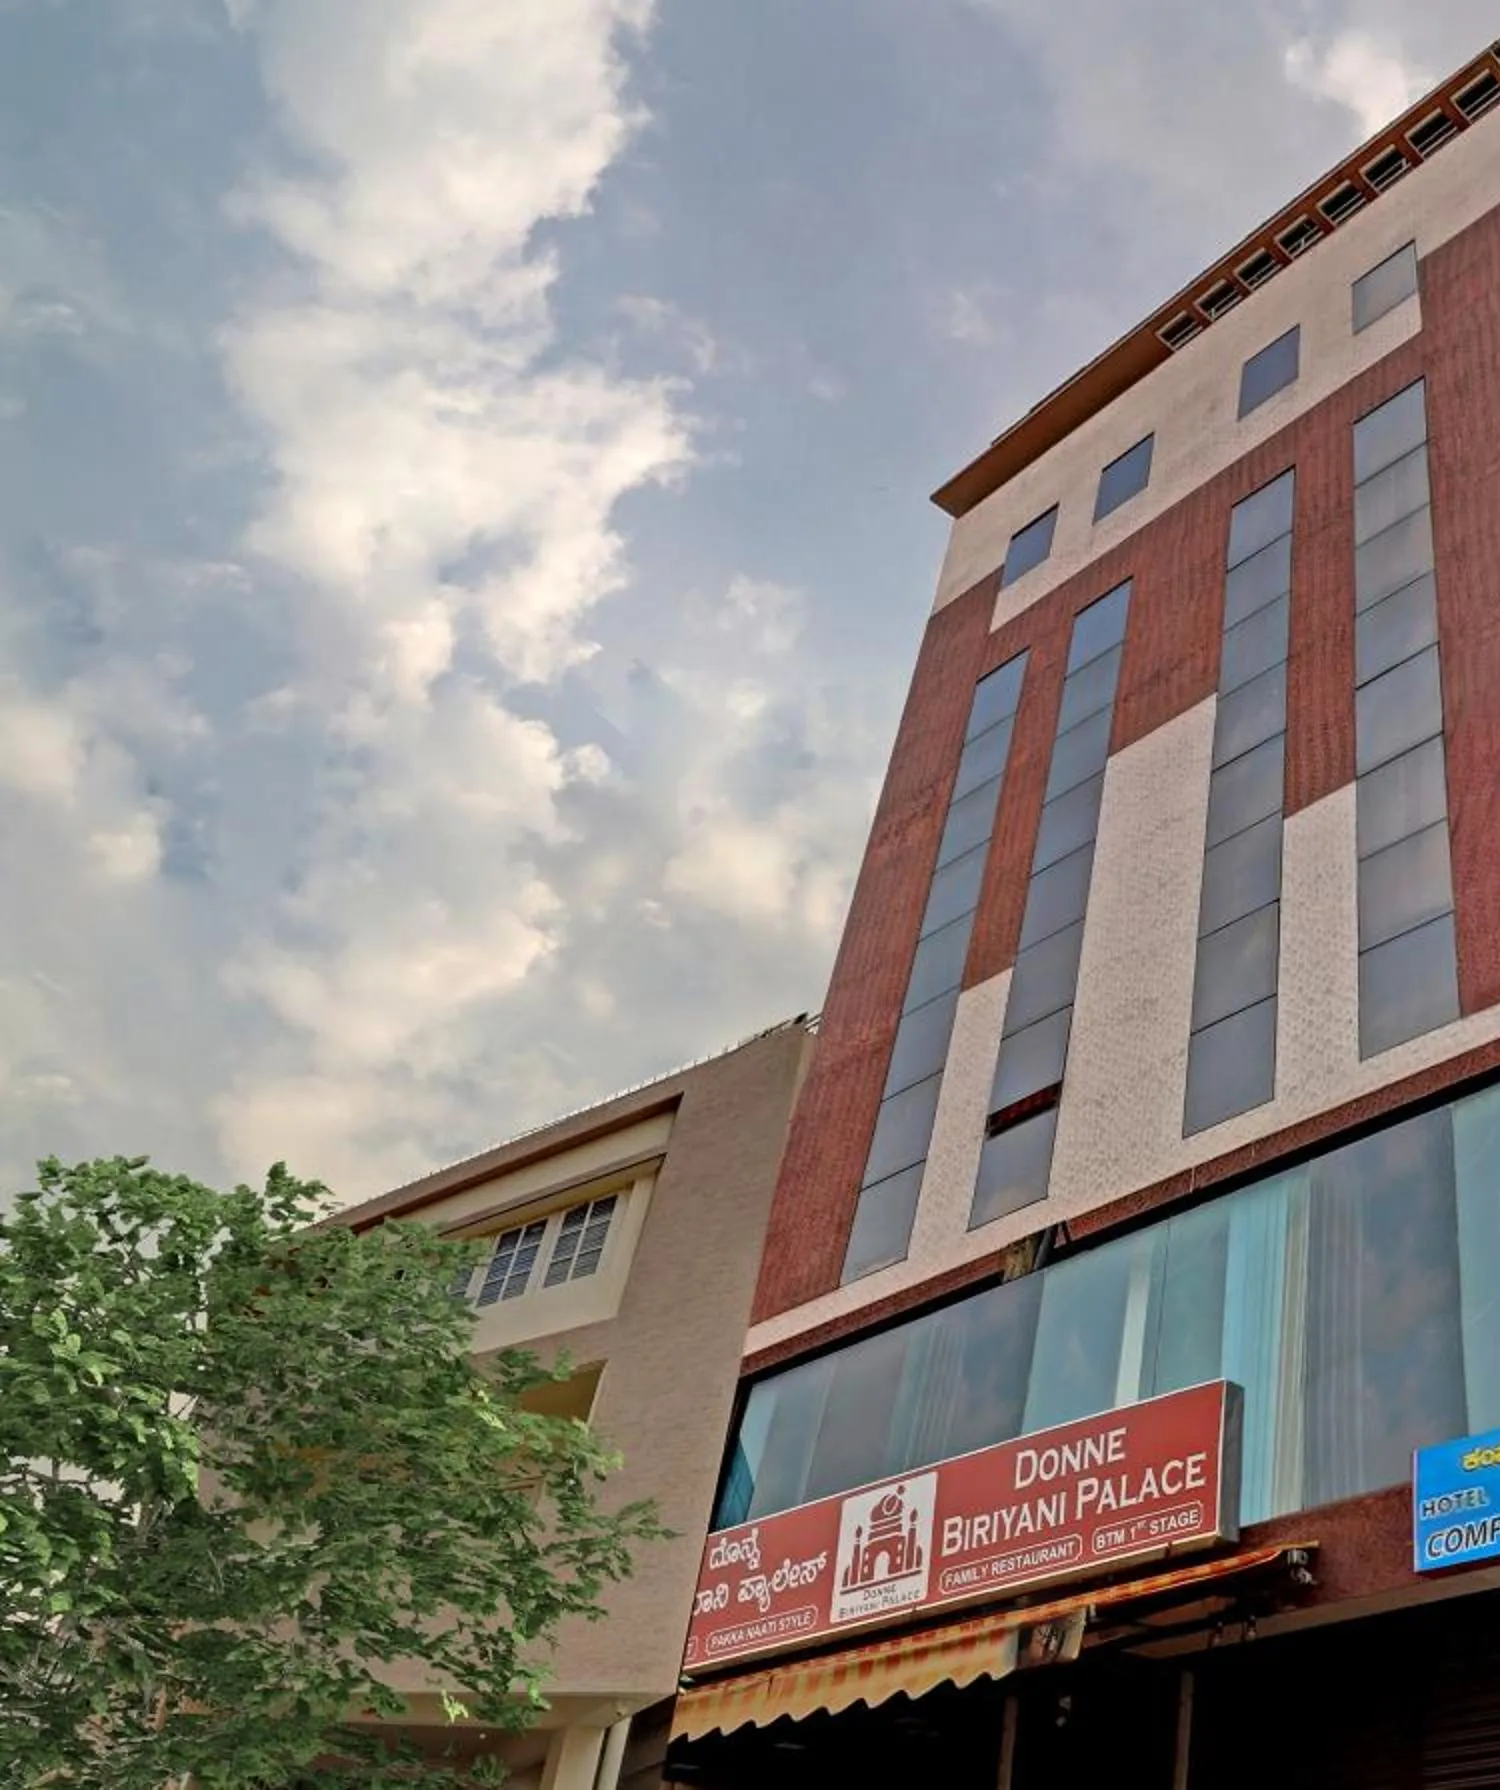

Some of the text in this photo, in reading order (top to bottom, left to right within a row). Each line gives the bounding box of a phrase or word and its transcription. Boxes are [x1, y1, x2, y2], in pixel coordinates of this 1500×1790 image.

[1015, 1428, 1127, 1489] DONNE
[941, 1453, 1208, 1557] BIRIYANI PALACE
[1421, 1488, 1487, 1518] HOTEL
[1096, 1528, 1125, 1549] BTM
[1149, 1508, 1199, 1535] STAGE
[944, 1541, 1076, 1587] FAMILY RESTAURANT
[711, 1629, 744, 1649] PAKKA
[779, 1611, 811, 1630] STYLE
